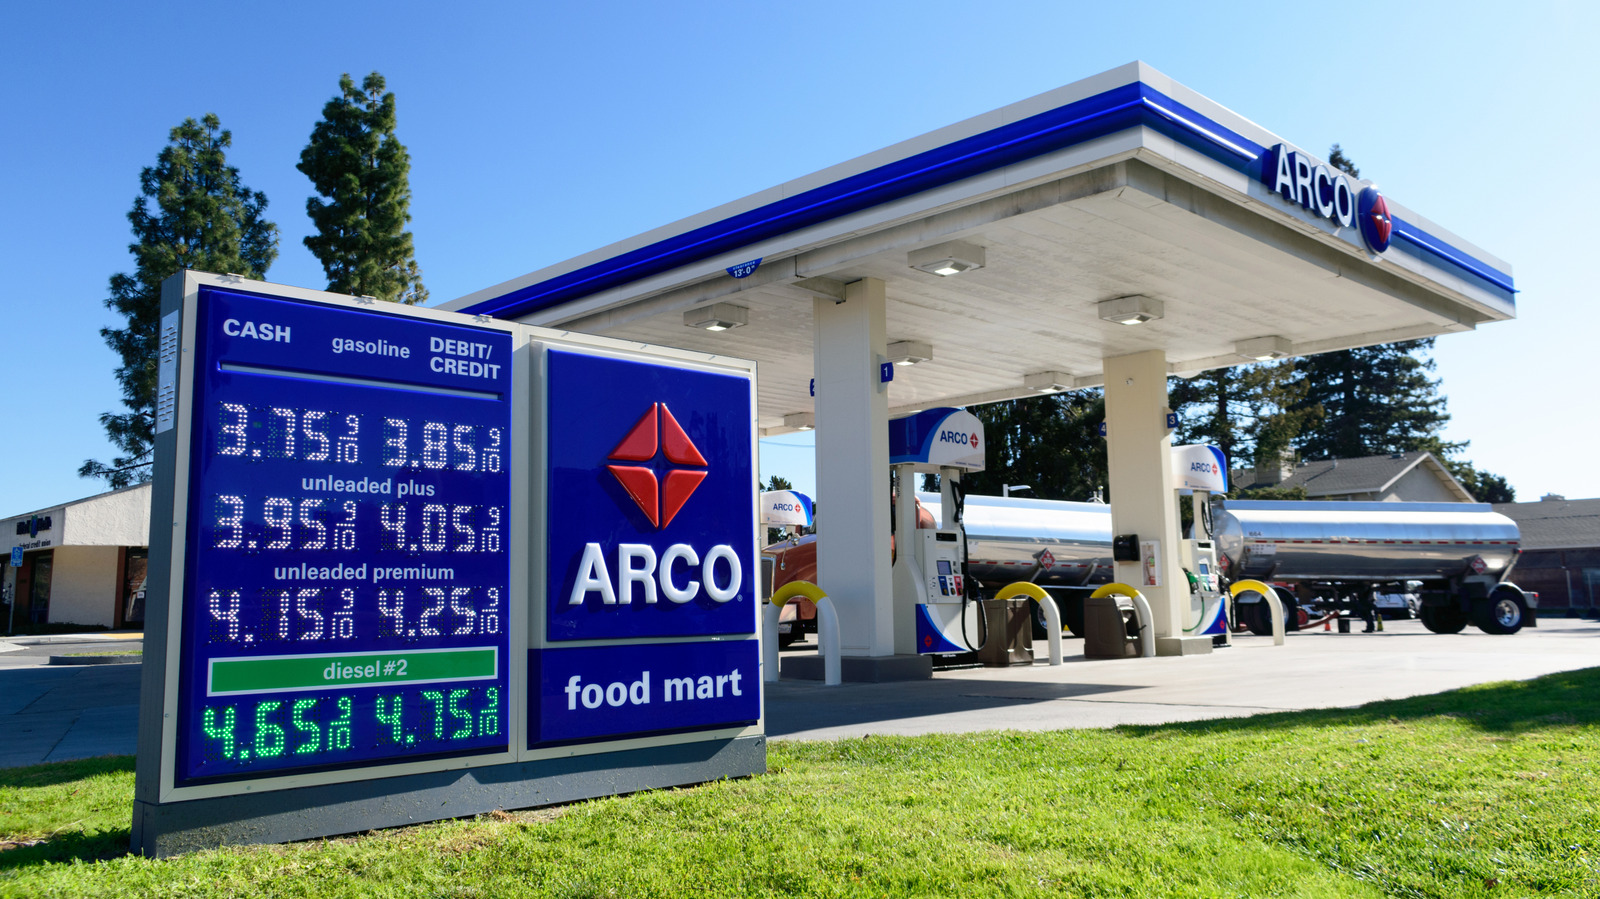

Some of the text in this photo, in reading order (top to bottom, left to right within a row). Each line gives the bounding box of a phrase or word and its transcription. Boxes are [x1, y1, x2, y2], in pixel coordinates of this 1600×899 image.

[1275, 144, 1354, 228] ARCO
[223, 319, 291, 343] CASH
[332, 336, 410, 360] gasoline
[430, 337, 493, 360] DEBIT/
[430, 356, 501, 380] CREDIT
[883, 366, 889, 377] 1
[219, 403, 330, 461] 3.75
[1169, 415, 1176, 425] 3
[385, 418, 474, 471] 3.85
[940, 430, 968, 445] ARCO
[1191, 462, 1211, 473] ARCO
[301, 475, 436, 498] unleaded plus
[773, 503, 793, 512] ARCO
[216, 495, 327, 549] 3.95
[381, 504, 475, 552] 4.05
[274, 563, 455, 584] unleaded premium
[569, 542, 742, 605] ARCO
[209, 588, 323, 642] 4.15
[378, 587, 474, 637] 4.25
[323, 659, 408, 681] diesel #2
[564, 668, 742, 710] food mart
[376, 690, 473, 744] 4.75
[204, 700, 321, 759] 4.65
